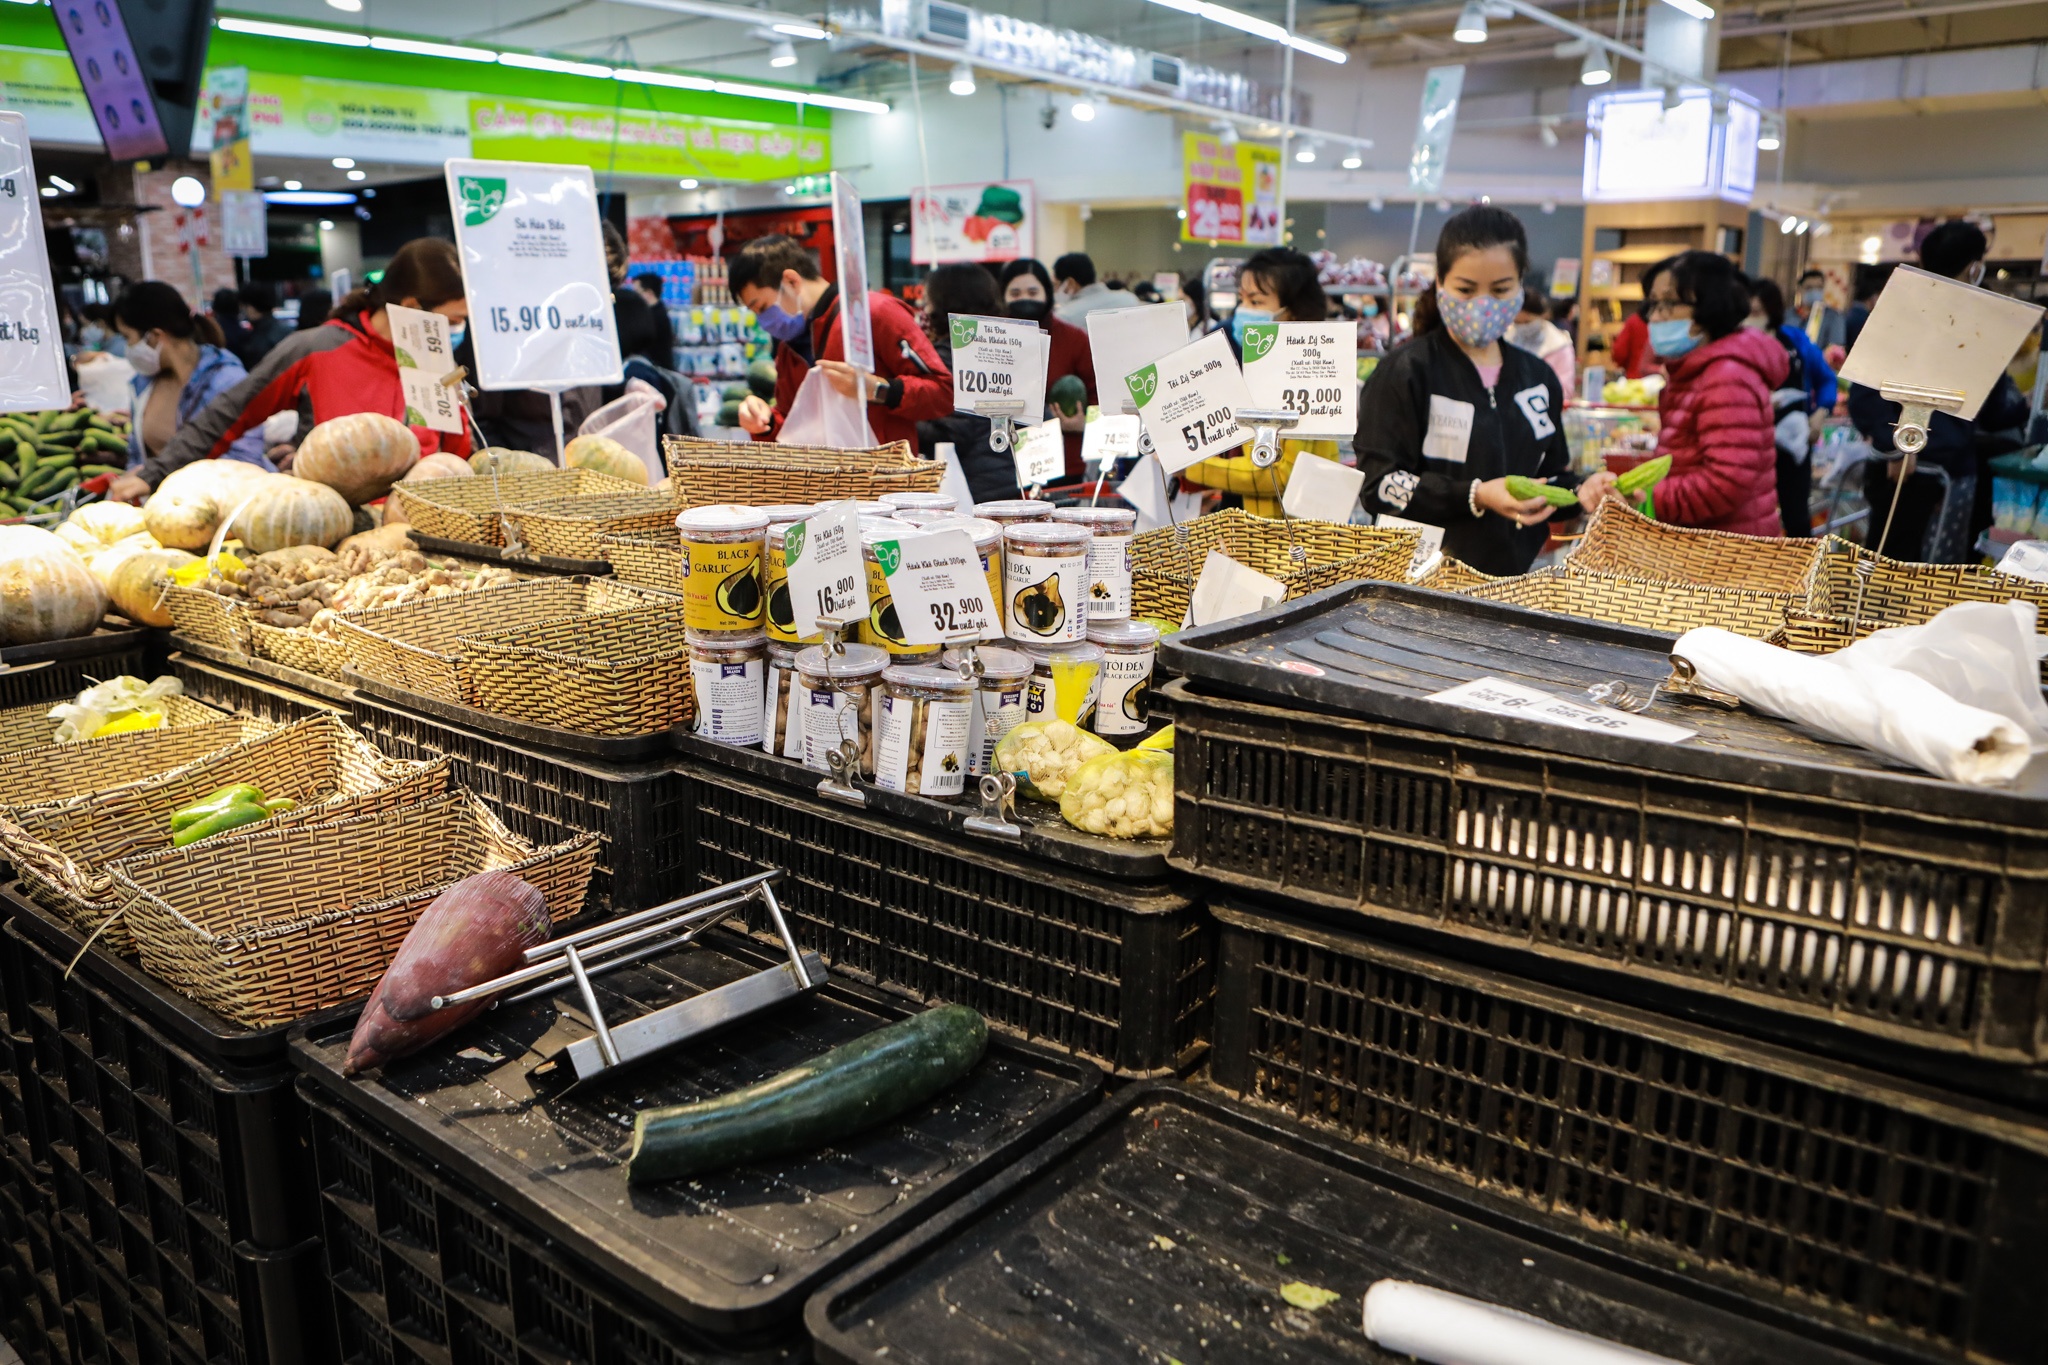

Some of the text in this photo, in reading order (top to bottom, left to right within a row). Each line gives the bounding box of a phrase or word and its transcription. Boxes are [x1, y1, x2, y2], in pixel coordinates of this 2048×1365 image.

[1286, 336, 1306, 345] Hành
[1302, 348, 1321, 359] 300g
[1311, 405, 1342, 417] vnđ/gói
[718, 549, 750, 560] BLACK
[694, 563, 732, 574] GARLIC
[1106, 659, 1145, 671] TỎI ĐEN
[1104, 672, 1143, 680] BLACK GARLIC
